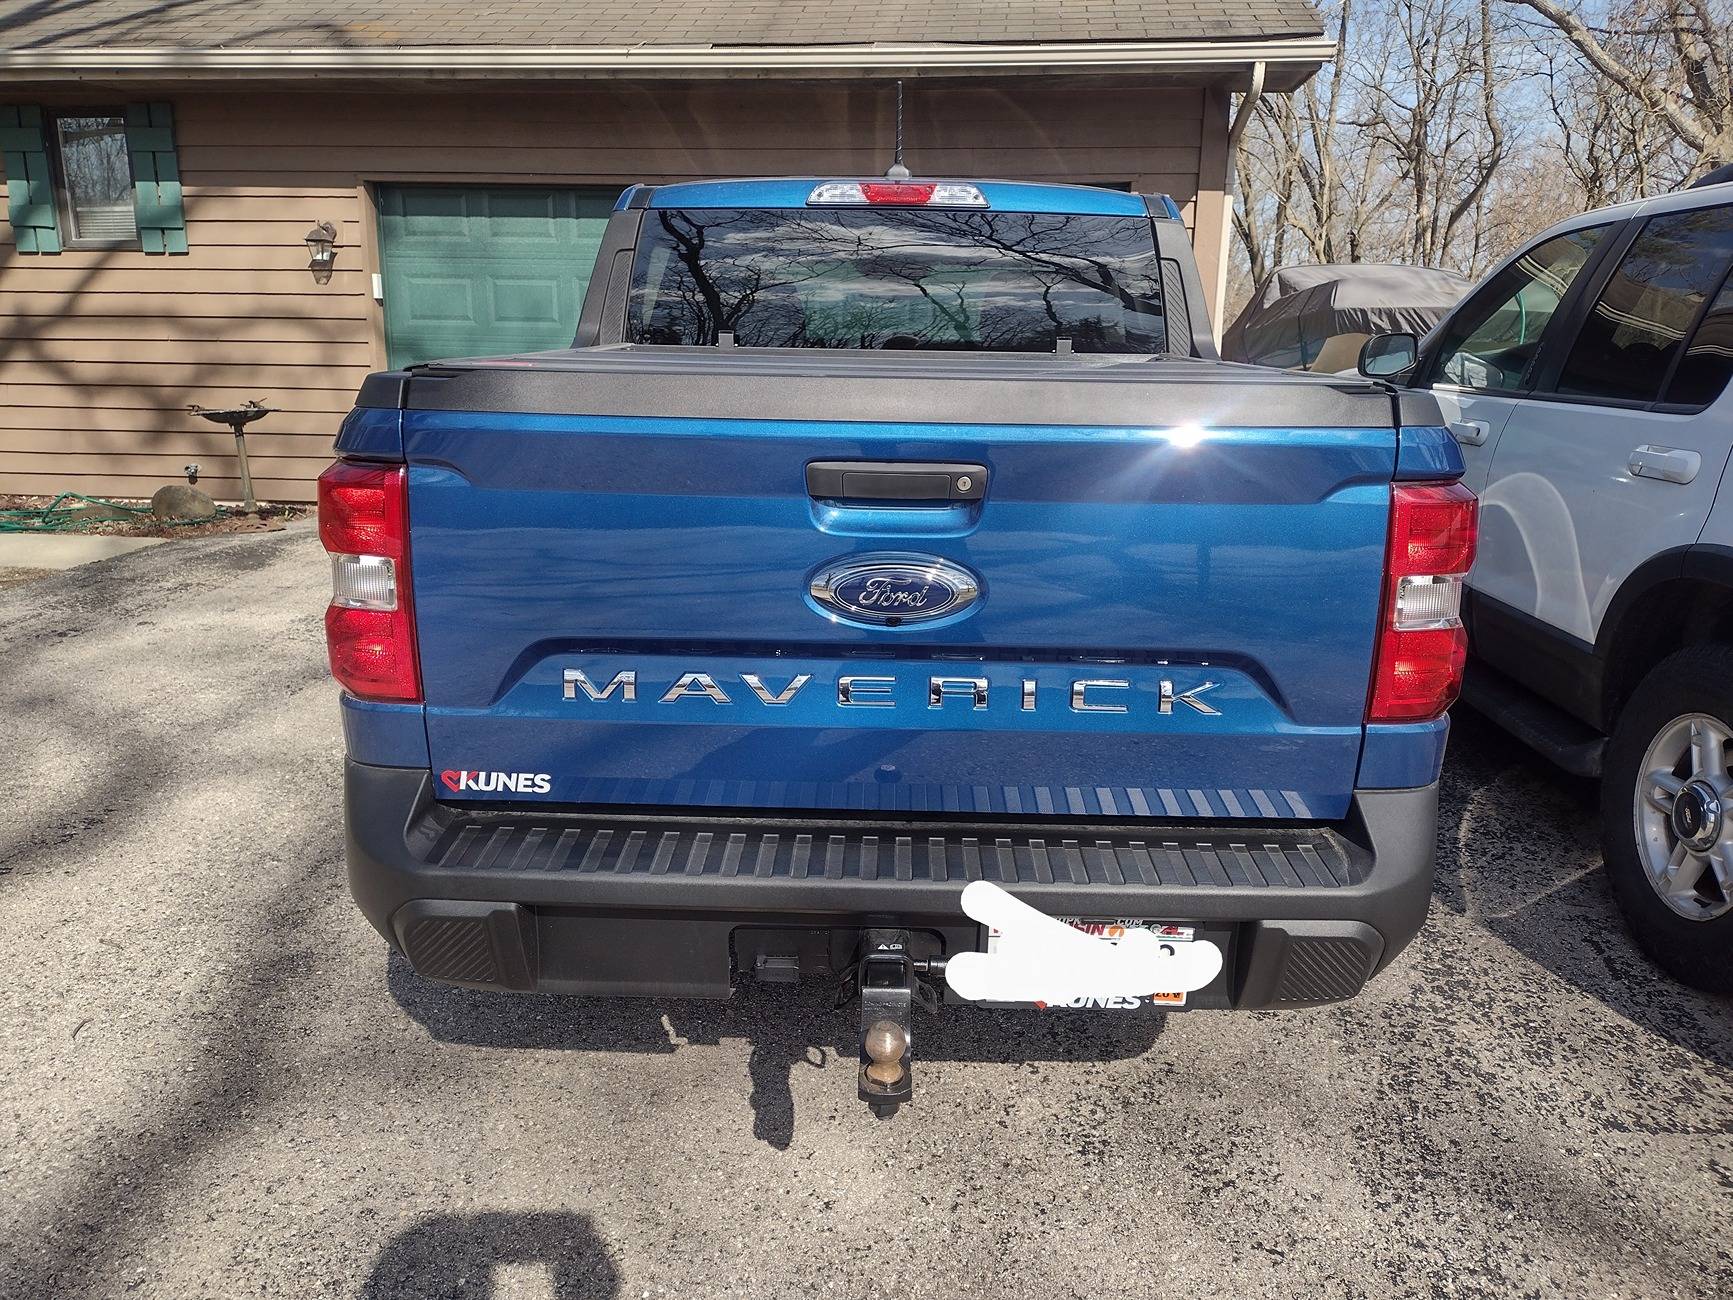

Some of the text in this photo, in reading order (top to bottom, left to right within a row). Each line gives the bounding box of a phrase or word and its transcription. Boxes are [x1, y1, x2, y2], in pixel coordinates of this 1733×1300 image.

[858, 577, 930, 607] Ford
[561, 668, 1224, 716] MAVERICK
[459, 770, 552, 794] KUNES
[1047, 994, 1142, 1010] UNES
